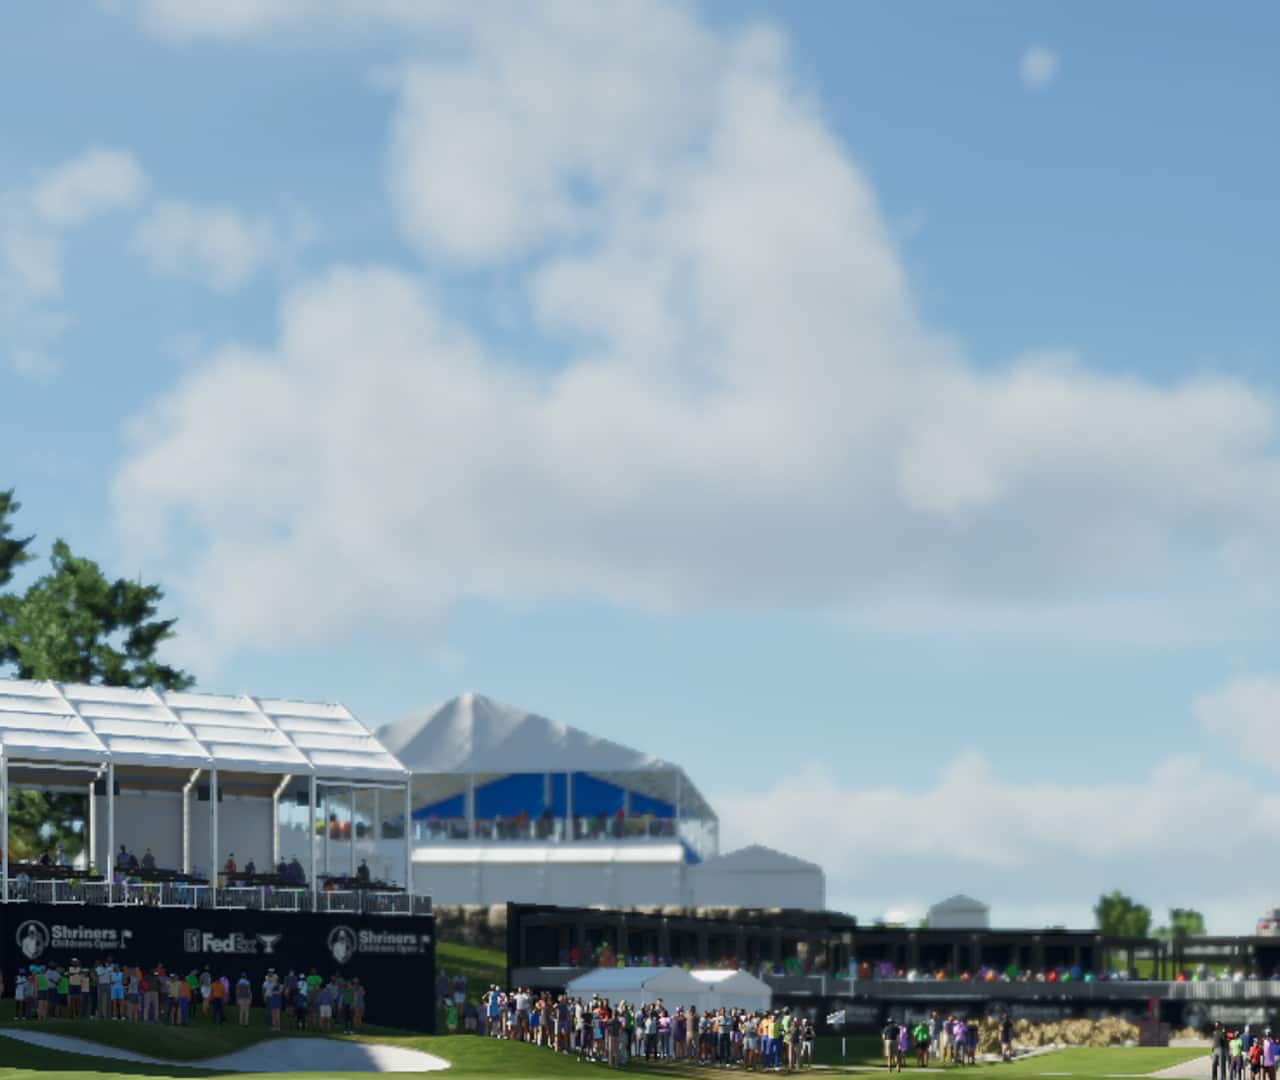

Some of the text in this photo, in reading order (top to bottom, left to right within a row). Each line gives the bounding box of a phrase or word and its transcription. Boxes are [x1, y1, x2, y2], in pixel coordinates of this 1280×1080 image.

[51, 925, 117, 940] Shriners
[359, 930, 417, 945] Shriners
[202, 933, 257, 954] FedEx
